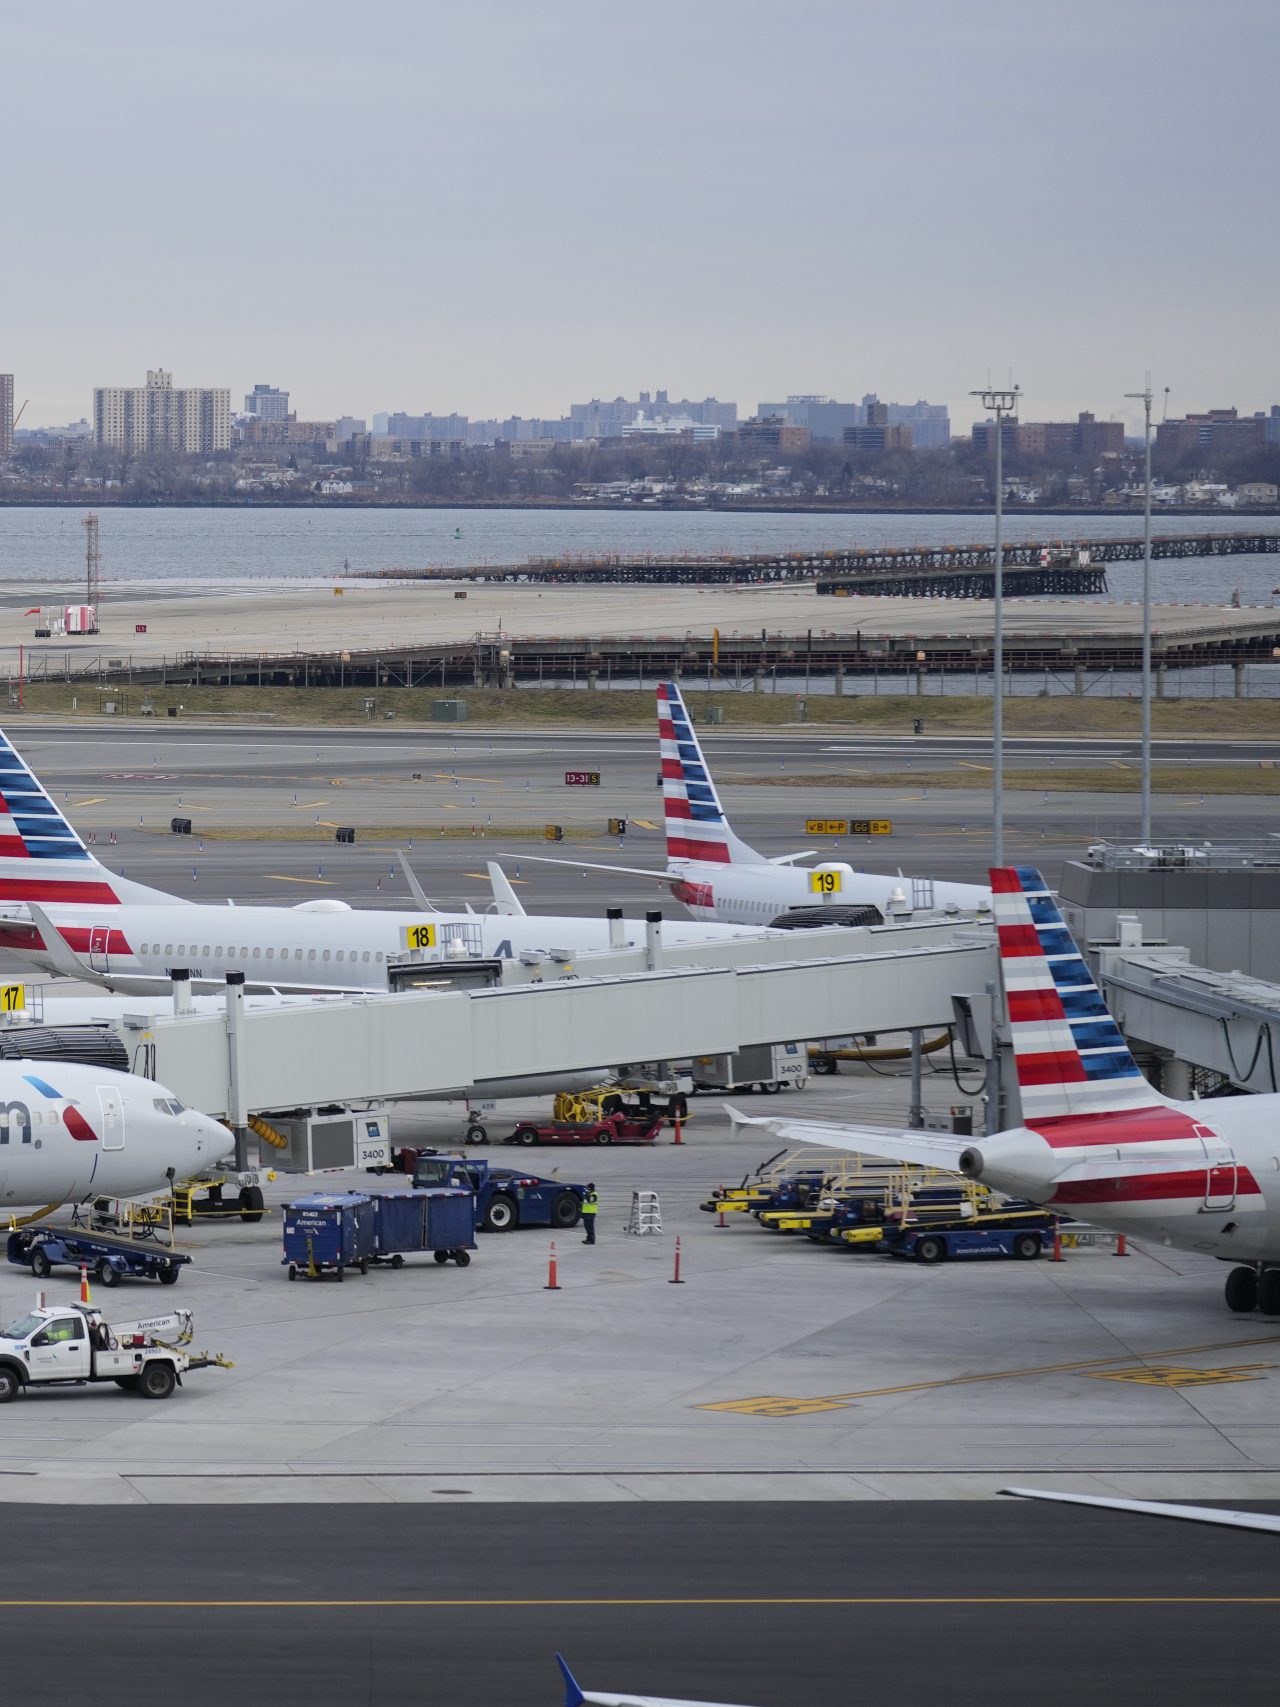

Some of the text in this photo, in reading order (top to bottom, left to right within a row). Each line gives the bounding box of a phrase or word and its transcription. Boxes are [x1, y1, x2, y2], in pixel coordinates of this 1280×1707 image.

[566, 774, 588, 782] 13-31
[818, 874, 834, 892] 19
[412, 927, 429, 947] 18
[5, 987, 19, 1010] 17
[781, 1065, 802, 1074] 3400
[362, 1149, 384, 1160] 3400
[137, 1318, 170, 1329] American
